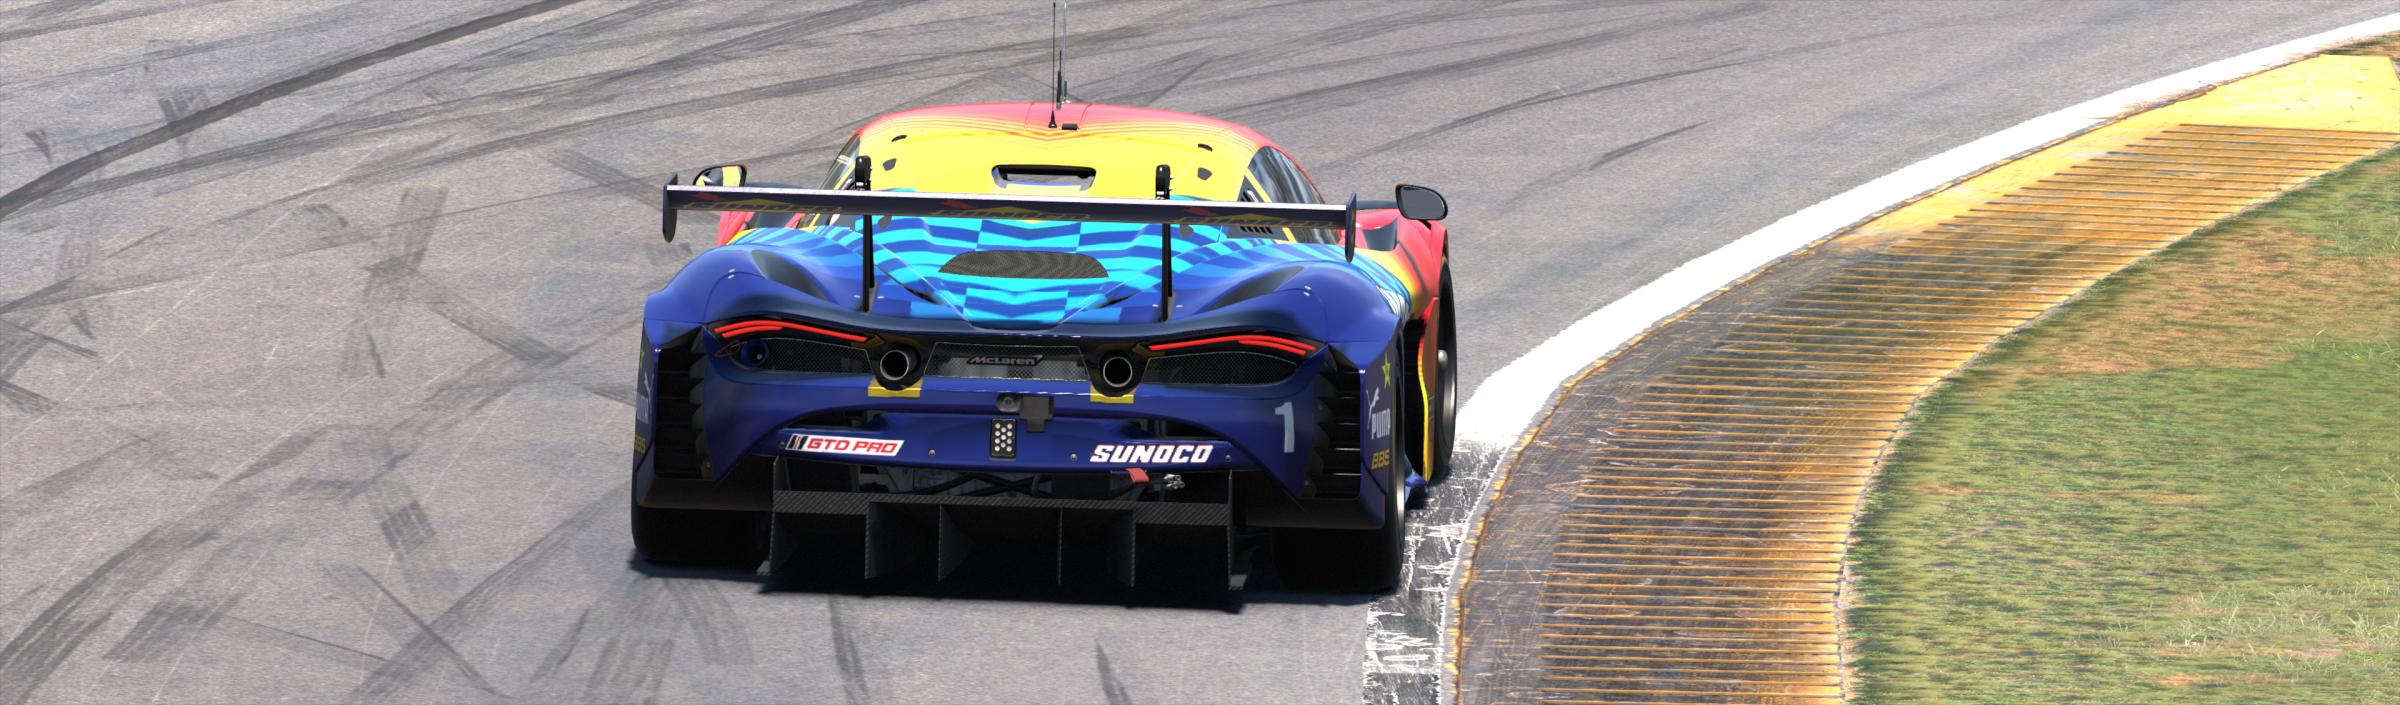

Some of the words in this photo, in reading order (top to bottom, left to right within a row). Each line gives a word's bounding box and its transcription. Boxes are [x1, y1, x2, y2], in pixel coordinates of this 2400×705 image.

[970, 355, 1035, 365] McLaren
[1274, 402, 1295, 453] 1
[1371, 408, 1391, 440] PUMA
[807, 438, 850, 451] GTD
[852, 441, 898, 453] PRO
[1089, 444, 1214, 463] SUNOCO
[1371, 448, 1390, 469] BBS
